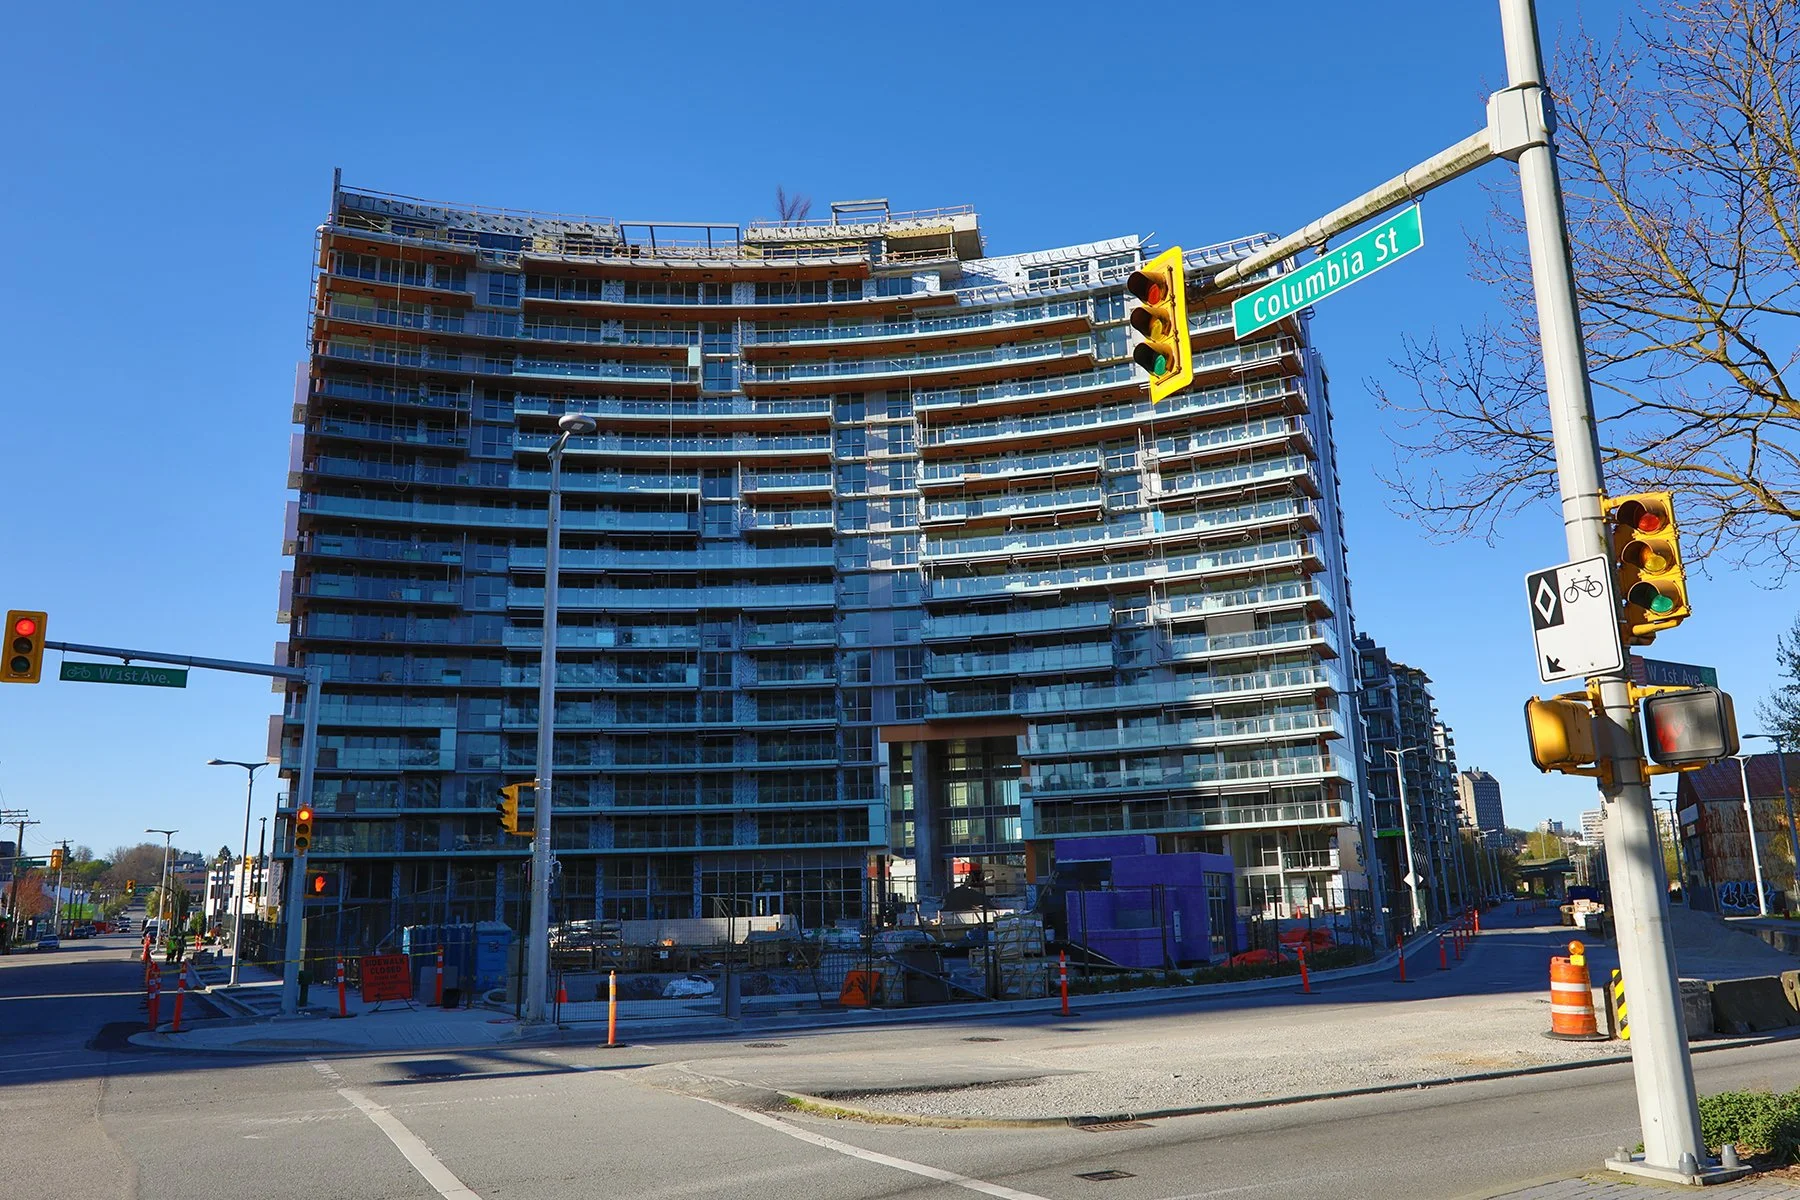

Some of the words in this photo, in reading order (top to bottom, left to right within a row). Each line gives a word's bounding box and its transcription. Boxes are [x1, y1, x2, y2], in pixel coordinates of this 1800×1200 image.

[1253, 251, 1364, 322] Columbia
[1374, 227, 1399, 262] St
[99, 667, 112, 679] W
[116, 669, 138, 682] 1st
[140, 671, 171, 684] Ave.
[1646, 664, 1657, 681] W
[1662, 667, 1679, 684] 1st
[1682, 669, 1700, 686] Ave
[365, 958, 404, 966] SIDEWALK
[370, 966, 402, 974] CLOSED
